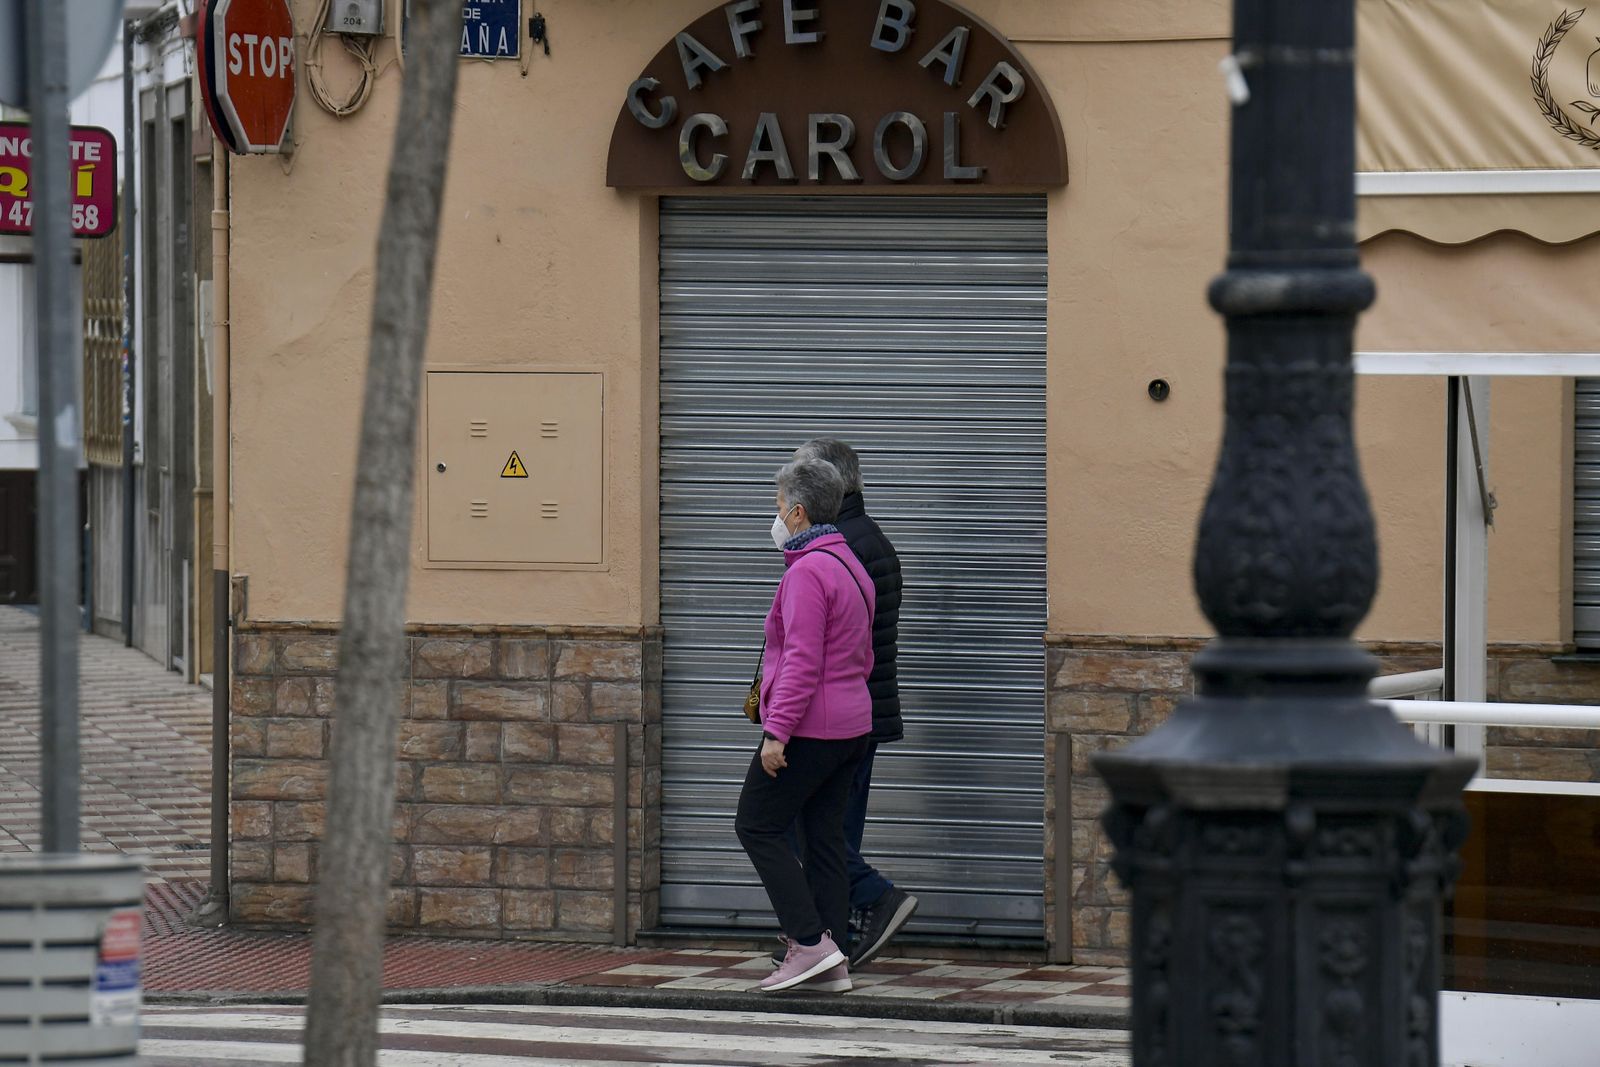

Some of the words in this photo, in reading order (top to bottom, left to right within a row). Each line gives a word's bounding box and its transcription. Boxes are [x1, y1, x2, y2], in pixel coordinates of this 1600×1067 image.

[343, 17, 362, 26] 204
[462, 8, 480, 19] DE
[228, 33, 291, 79] STOP
[870, 0, 1026, 129] BAR
[679, 111, 988, 182] CAROL
[0, 163, 96, 197] QÍ
